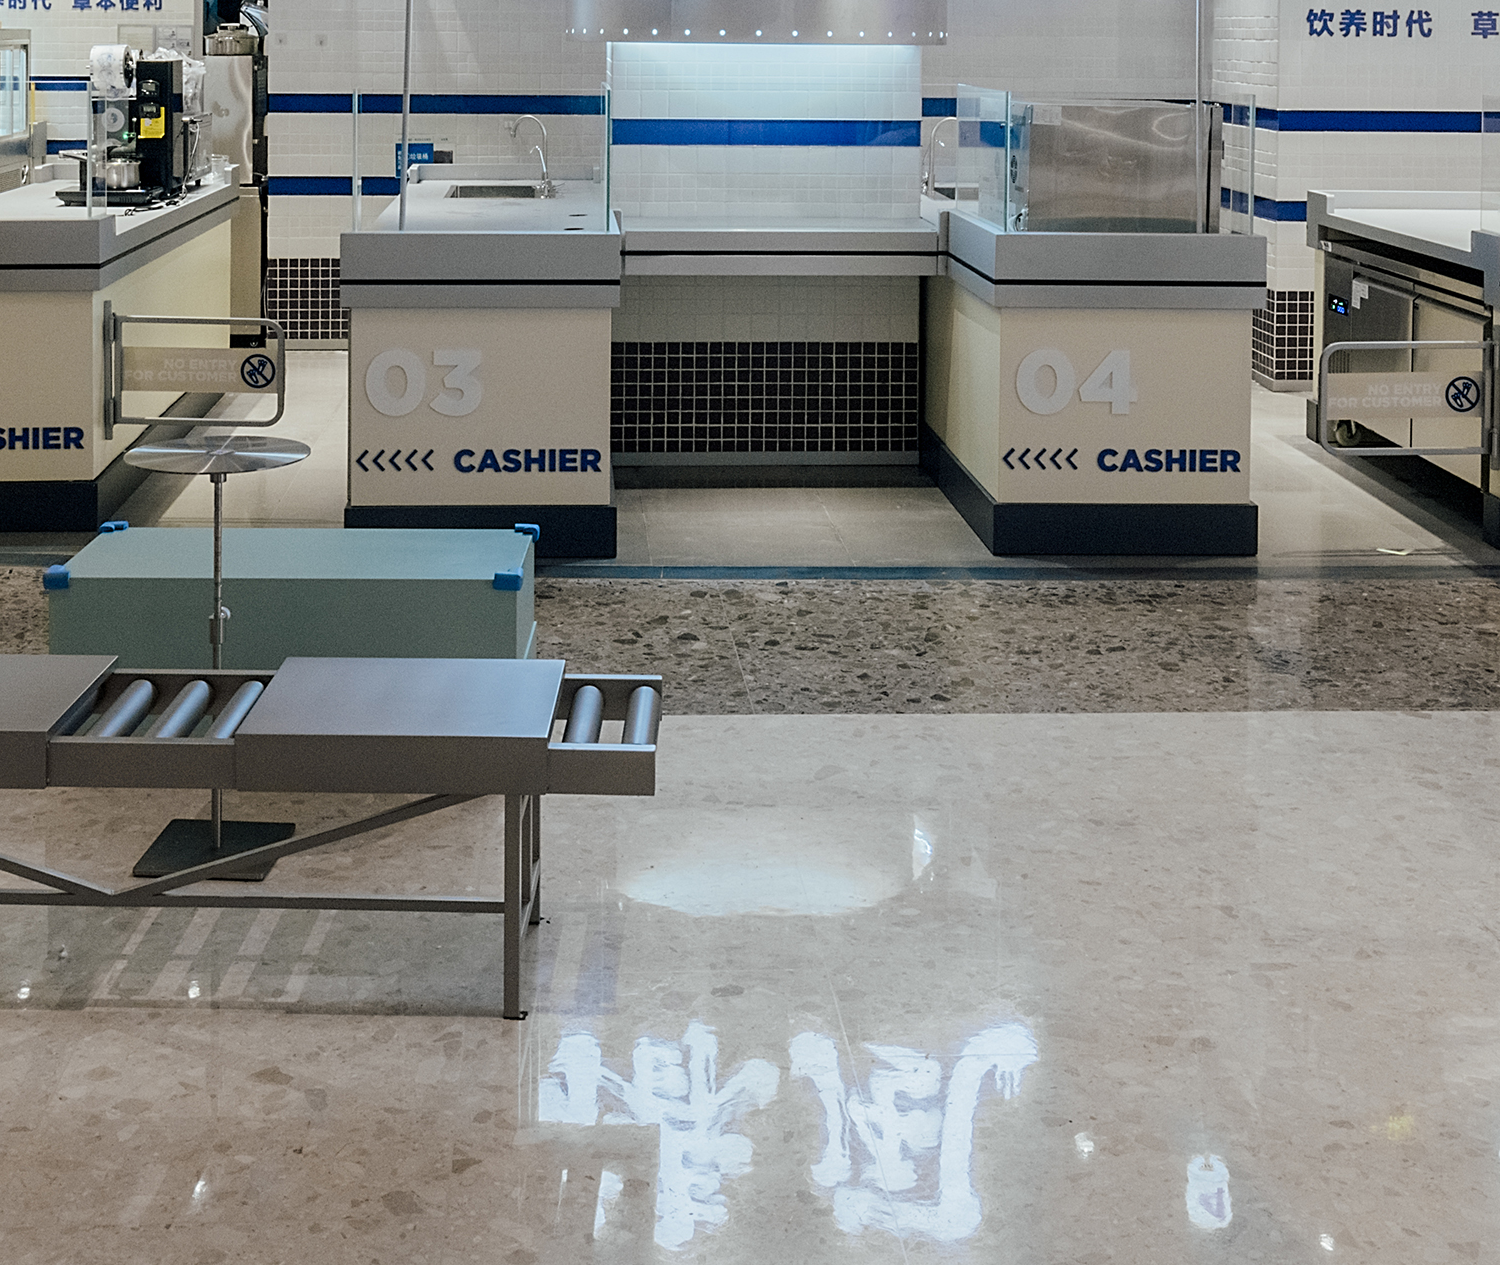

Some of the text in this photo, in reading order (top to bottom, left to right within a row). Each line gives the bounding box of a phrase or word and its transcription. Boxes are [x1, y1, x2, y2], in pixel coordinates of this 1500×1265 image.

[1306, 8, 1433, 38] 饮养时代
[125, 370, 238, 382] FOR CUSTOMER
[164, 359, 237, 370] NO ENTRY
[365, 349, 484, 416] 03
[1015, 348, 1139, 414] 04
[1368, 384, 1442, 396] NO ENTRY
[1329, 396, 1442, 408] FOR CUSTOMER
[453, 448, 602, 474] CASHIER
[1096, 448, 1241, 473] CASHIER
